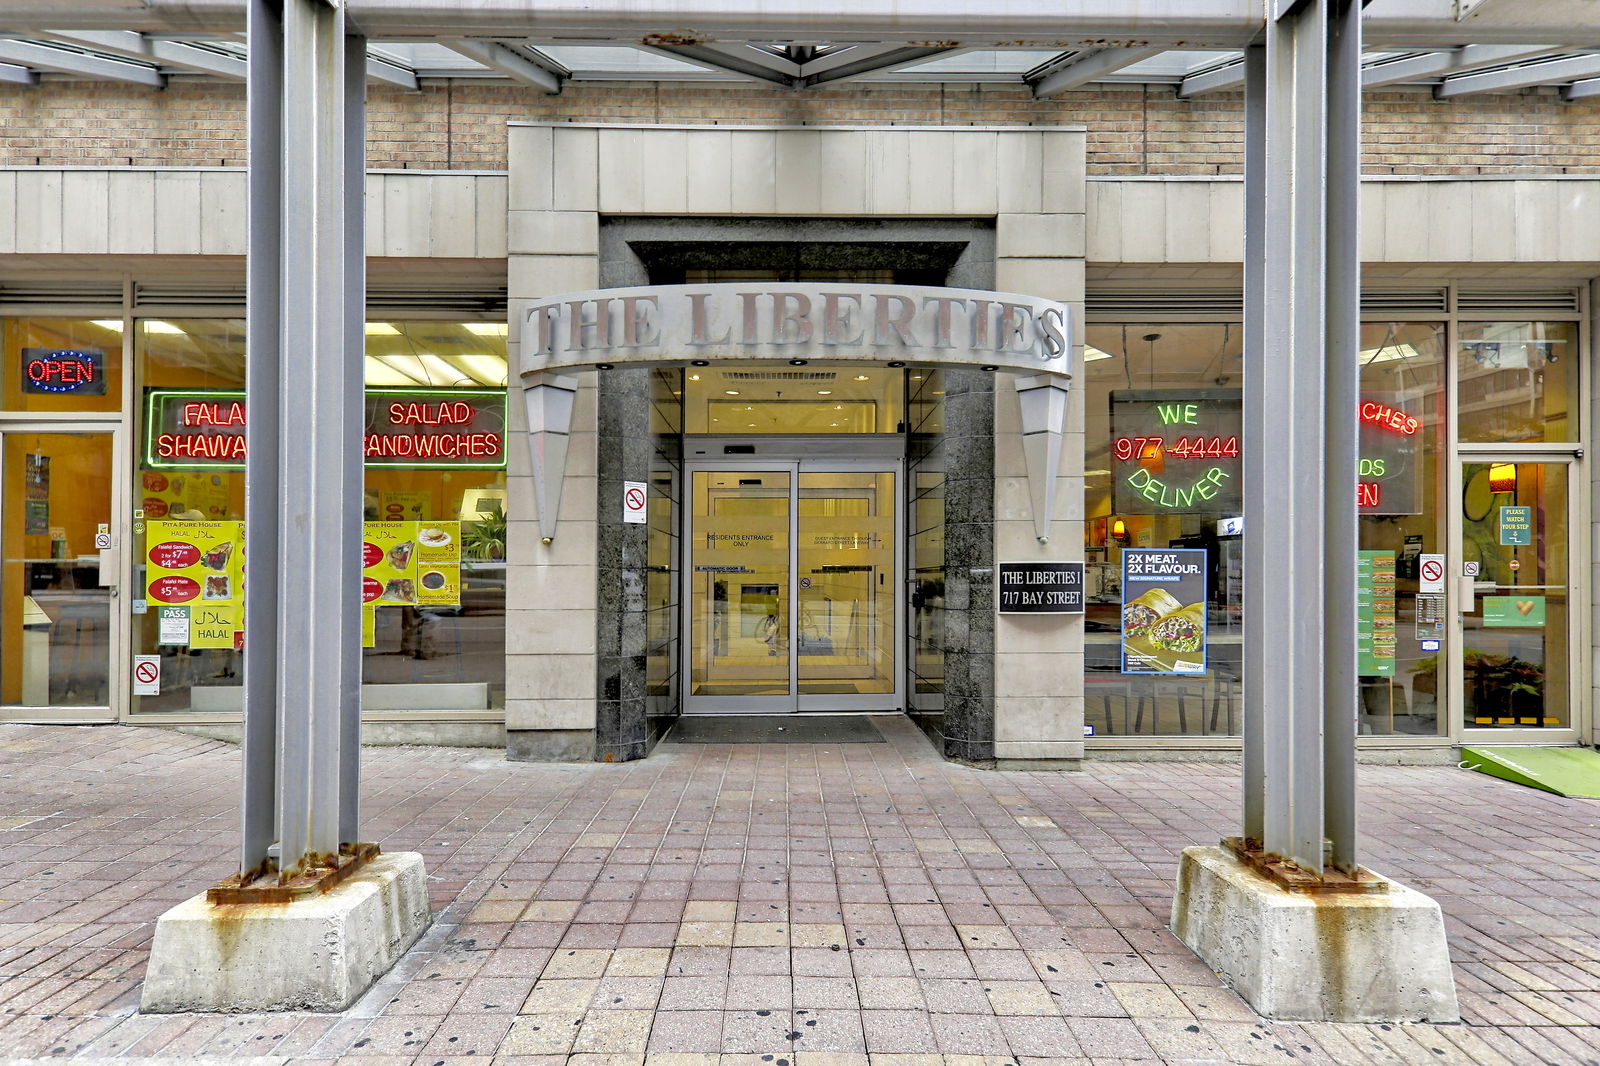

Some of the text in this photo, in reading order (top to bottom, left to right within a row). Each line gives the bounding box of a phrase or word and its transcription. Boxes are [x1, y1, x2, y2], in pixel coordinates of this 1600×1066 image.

[527, 292, 1066, 362] THE LIBERTIES
[28, 359, 93, 383] OPEN
[390, 402, 470, 424] SALAD
[1157, 404, 1197, 424] WE
[363, 434, 498, 456] ANDWICHES
[1117, 437, 1238, 460] 977-4444
[1128, 467, 1229, 507] DELIVER
[1128, 554, 1178, 563] 2X MEAT.
[1128, 564, 1201, 573] 2X FLAVOUR.
[1002, 571, 1080, 584] THE LIBERTIES I
[1002, 591, 1080, 604] 717 BAY STREET
[164, 610, 186, 618] PASS
[194, 612, 231, 624] حلال
[198, 630, 229, 638] HALAL
